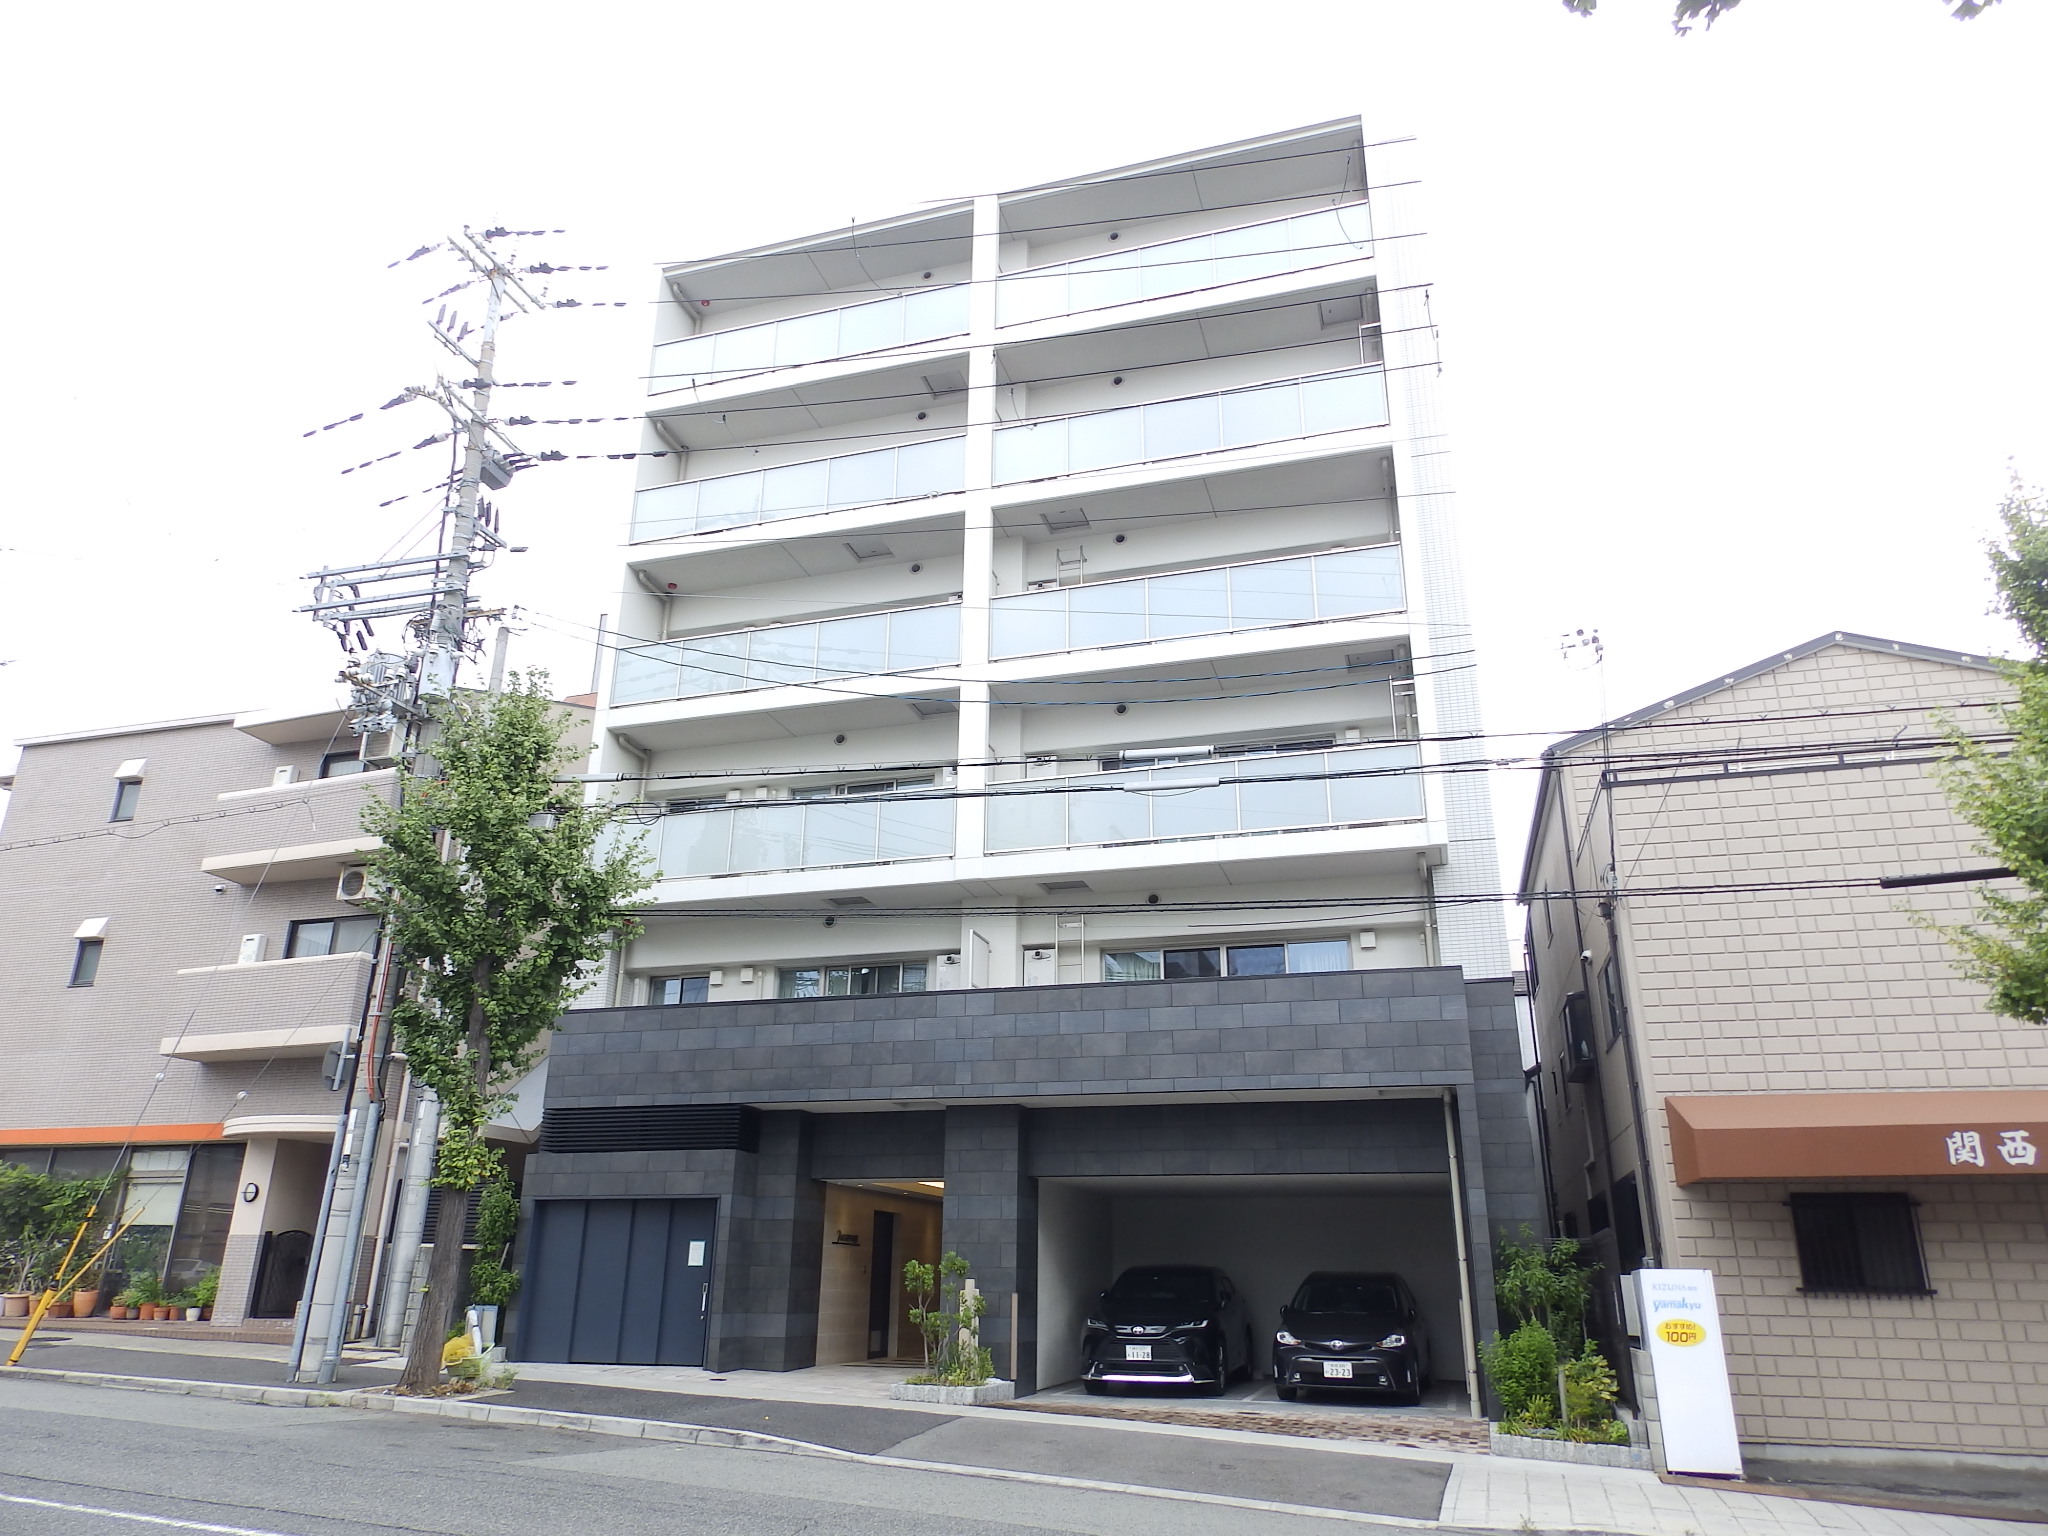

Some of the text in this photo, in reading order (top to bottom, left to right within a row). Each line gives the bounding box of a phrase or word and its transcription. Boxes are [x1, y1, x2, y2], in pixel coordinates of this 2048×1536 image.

[1945, 1130, 2038, 1168] 関西
[1652, 1297, 1702, 1313] yamakyu
[1666, 1331, 1697, 1343] 100円
[1330, 1368, 1351, 1377] 23-23
